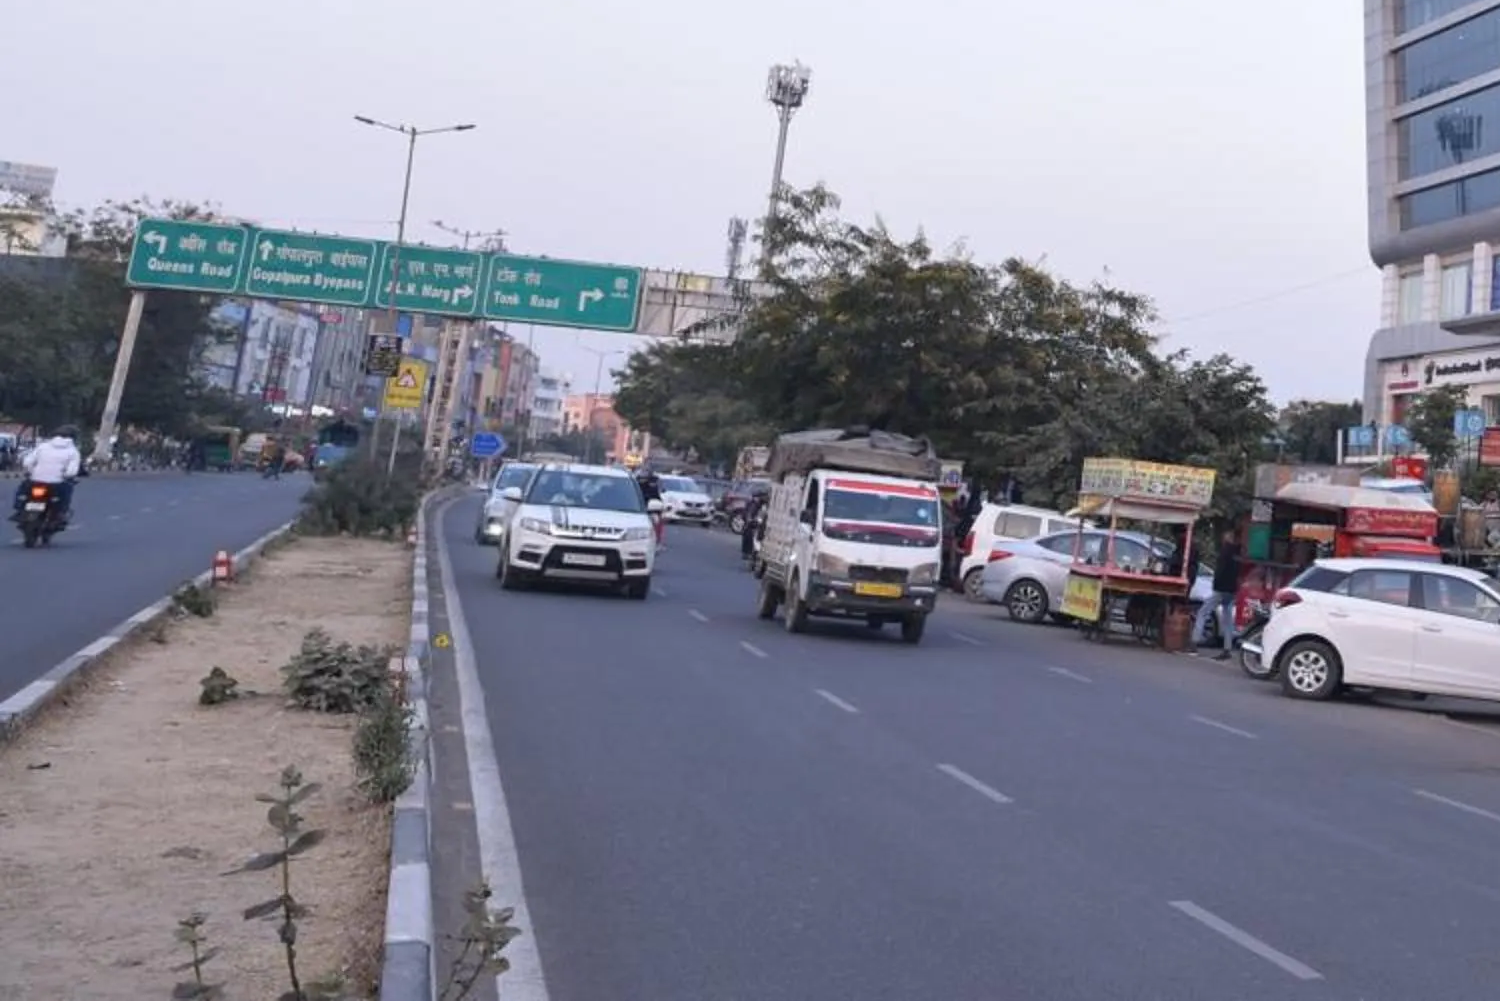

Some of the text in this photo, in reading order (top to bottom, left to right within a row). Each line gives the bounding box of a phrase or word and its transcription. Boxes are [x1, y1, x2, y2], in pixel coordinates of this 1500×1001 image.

[147, 257, 233, 278] Queens Road
[253, 267, 311, 287] Gopalpura
[421, 284, 451, 303] Marg
[493, 291, 560, 310] Tonk Road
